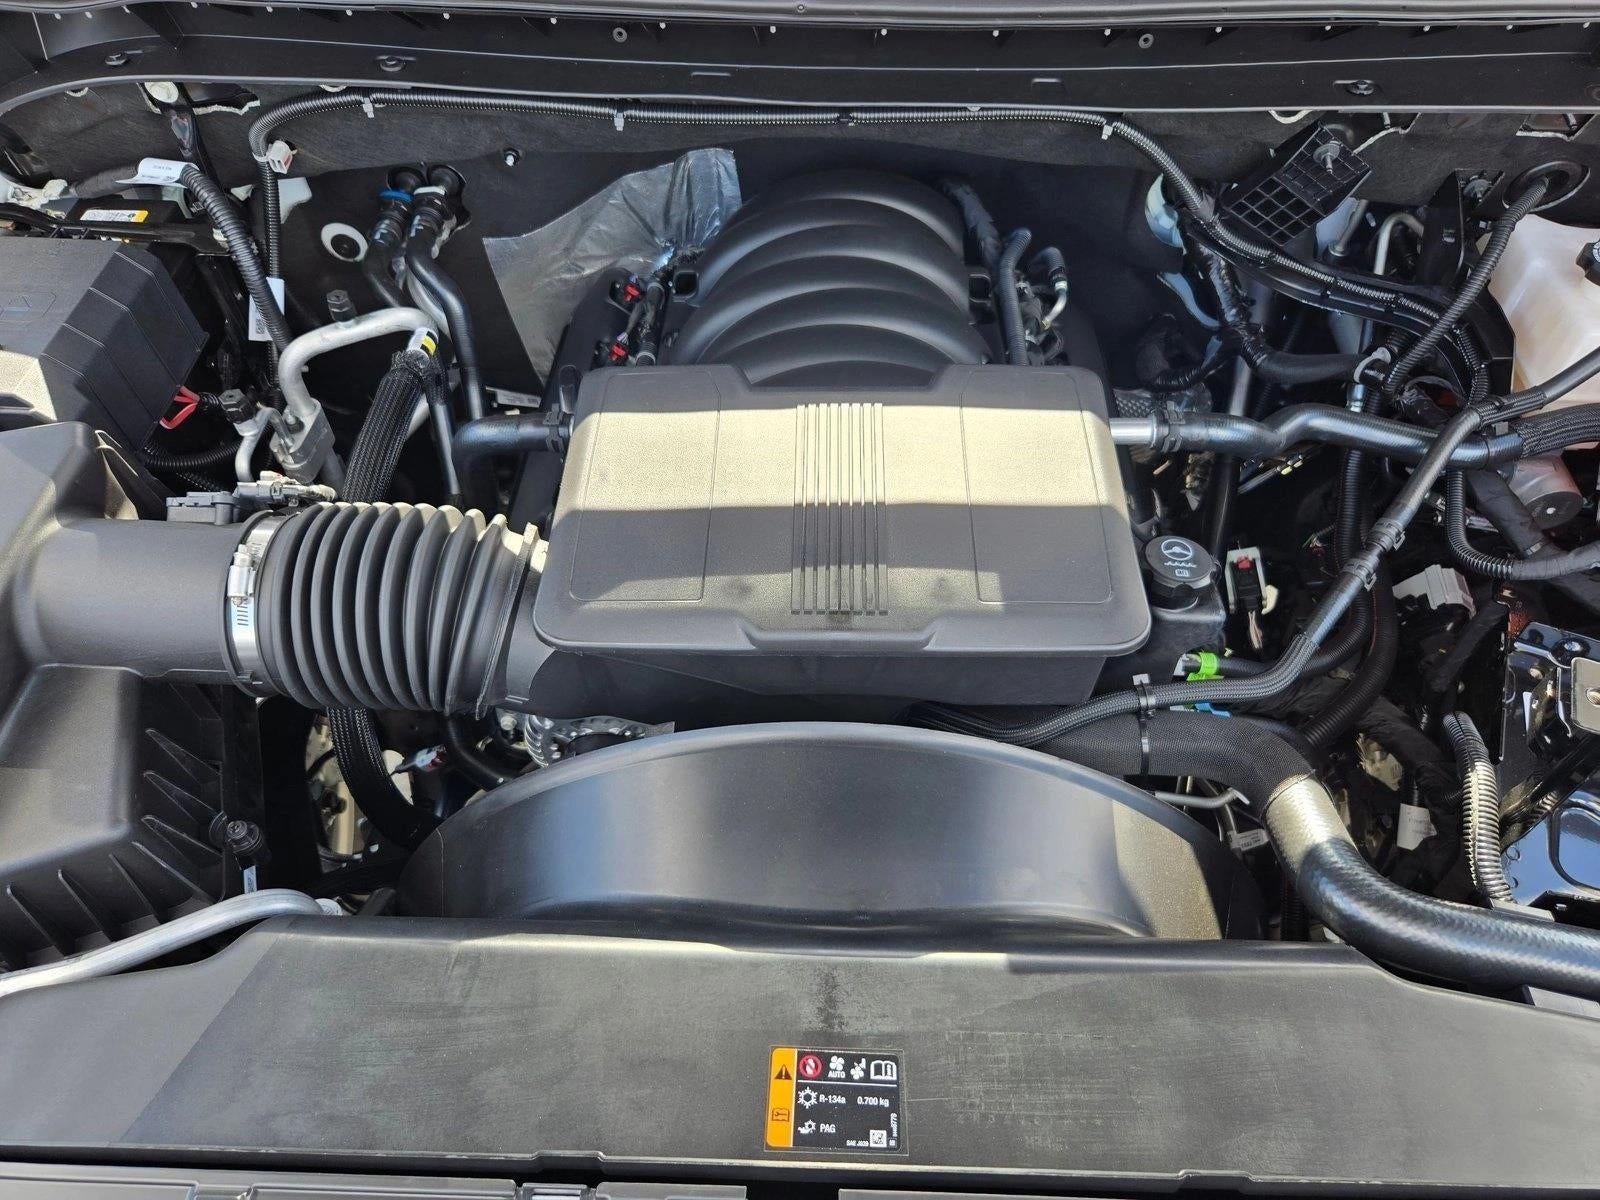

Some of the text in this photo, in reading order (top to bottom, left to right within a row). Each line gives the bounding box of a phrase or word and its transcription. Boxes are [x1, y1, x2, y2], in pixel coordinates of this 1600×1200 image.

[828, 1070, 846, 1079] AUTO
[819, 1094, 890, 1108] R-134a 0.700 kg
[819, 1123, 836, 1133] PAG
